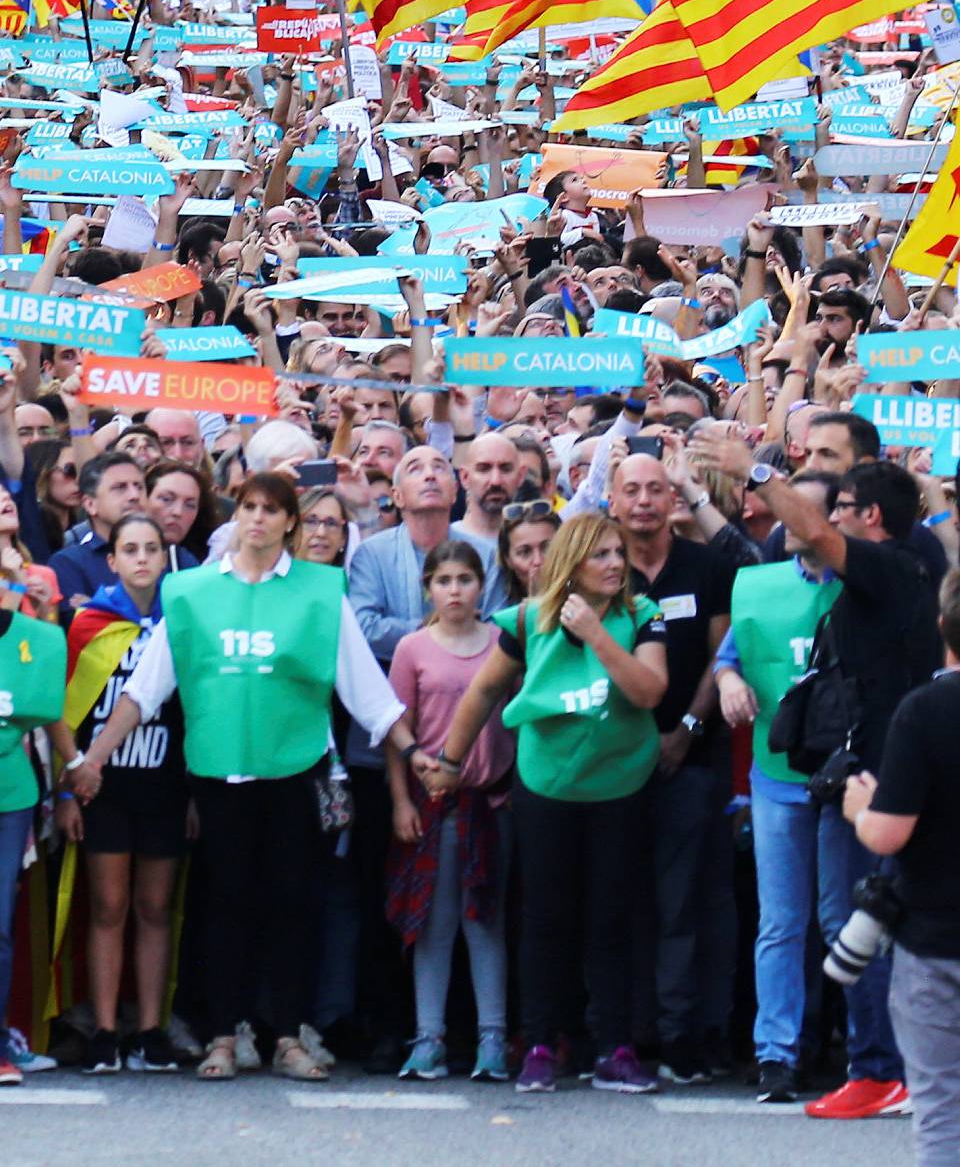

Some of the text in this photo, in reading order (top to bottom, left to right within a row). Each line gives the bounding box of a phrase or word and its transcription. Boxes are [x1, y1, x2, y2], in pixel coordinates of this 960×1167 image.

[708, 101, 804, 124] LLIBERTAT
[18, 168, 166, 185] HELP CATALONIA
[452, 352, 635, 372] HELP CATALONIA
[869, 346, 924, 367] HELP
[90, 368, 271, 404] SAVE EUROPE
[219, 629, 276, 658] 11S
[559, 677, 609, 714] 11S
